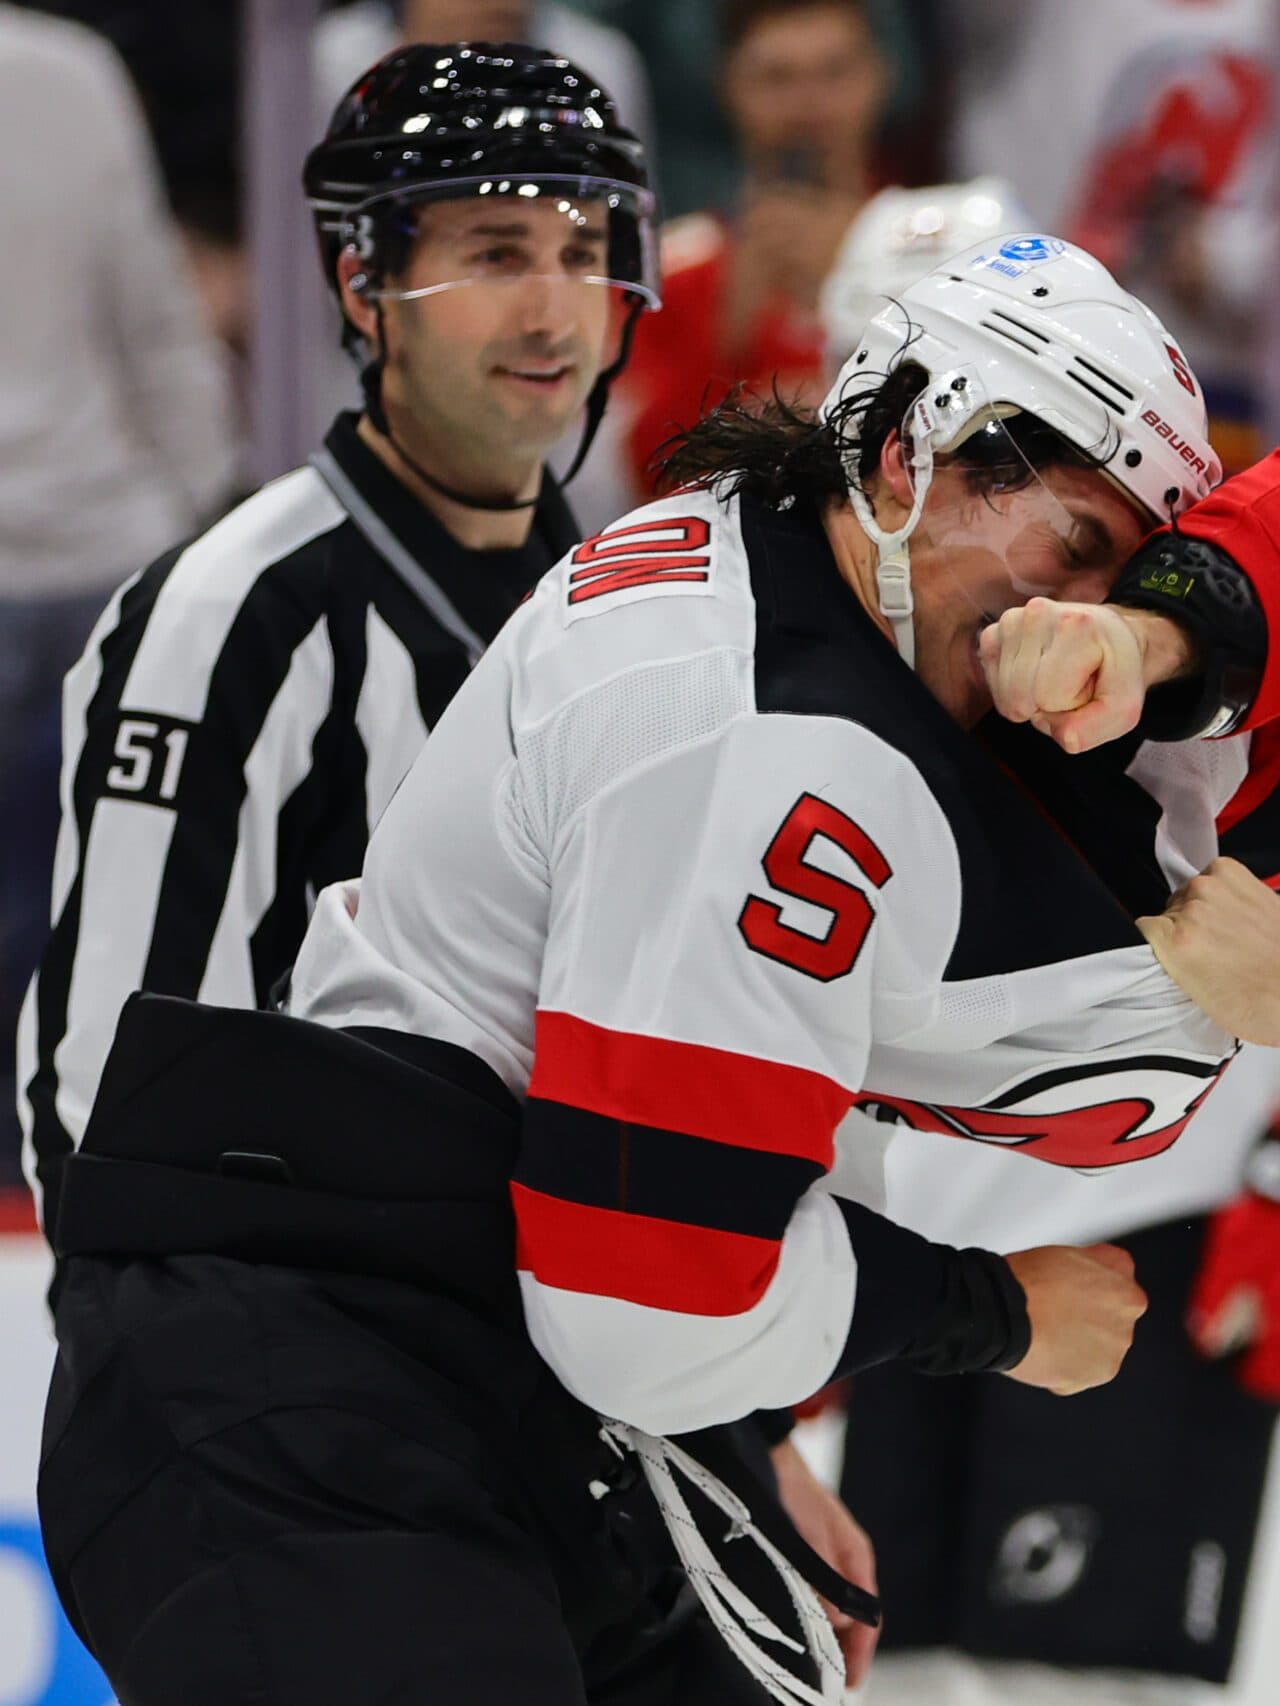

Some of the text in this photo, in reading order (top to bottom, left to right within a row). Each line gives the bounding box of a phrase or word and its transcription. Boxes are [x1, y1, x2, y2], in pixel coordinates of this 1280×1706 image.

[567, 512, 712, 606] ON
[106, 719, 189, 800] 51
[737, 790, 894, 983] 5
